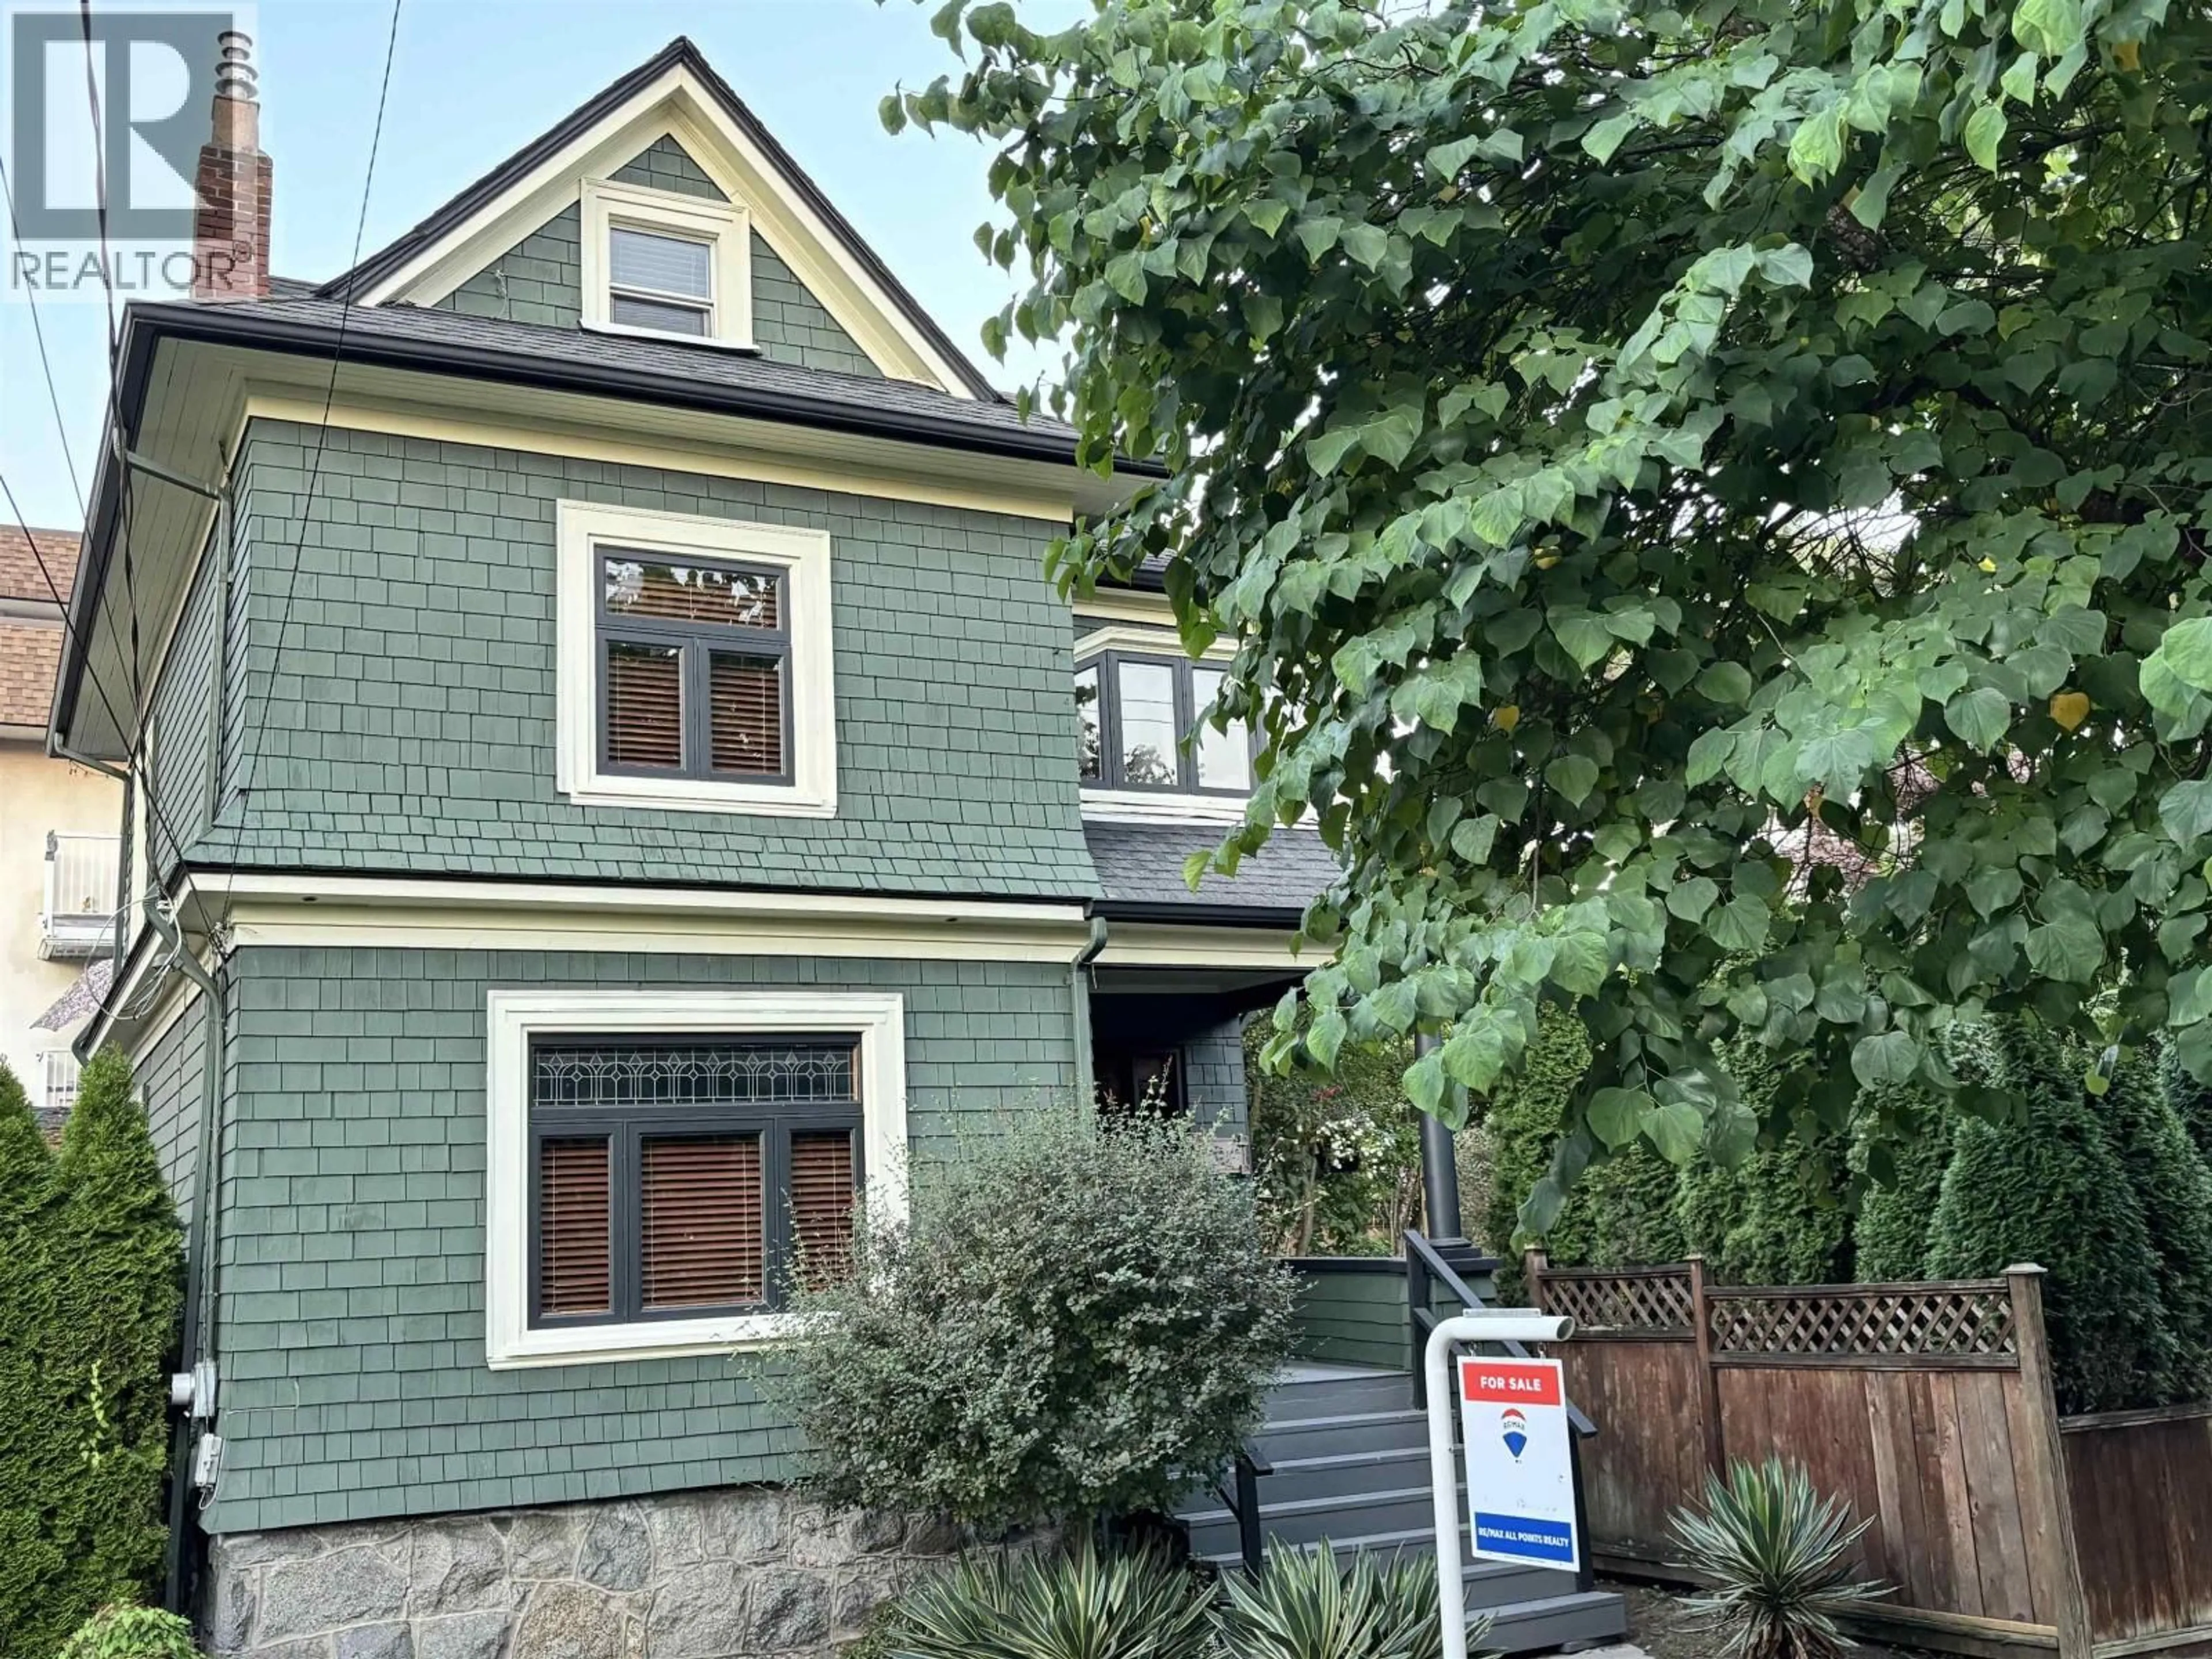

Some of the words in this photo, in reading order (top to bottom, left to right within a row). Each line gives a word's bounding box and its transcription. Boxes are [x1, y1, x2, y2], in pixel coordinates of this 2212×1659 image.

[1480, 1376, 1505, 1389] FOR
[1509, 1377, 1541, 1391] SALE
[1478, 1527, 1503, 1537] RE/MAX
[1505, 1531, 1517, 1541] ALL
[1518, 1532, 1543, 1543] POINTS
[1544, 1535, 1569, 1547] REALTY
